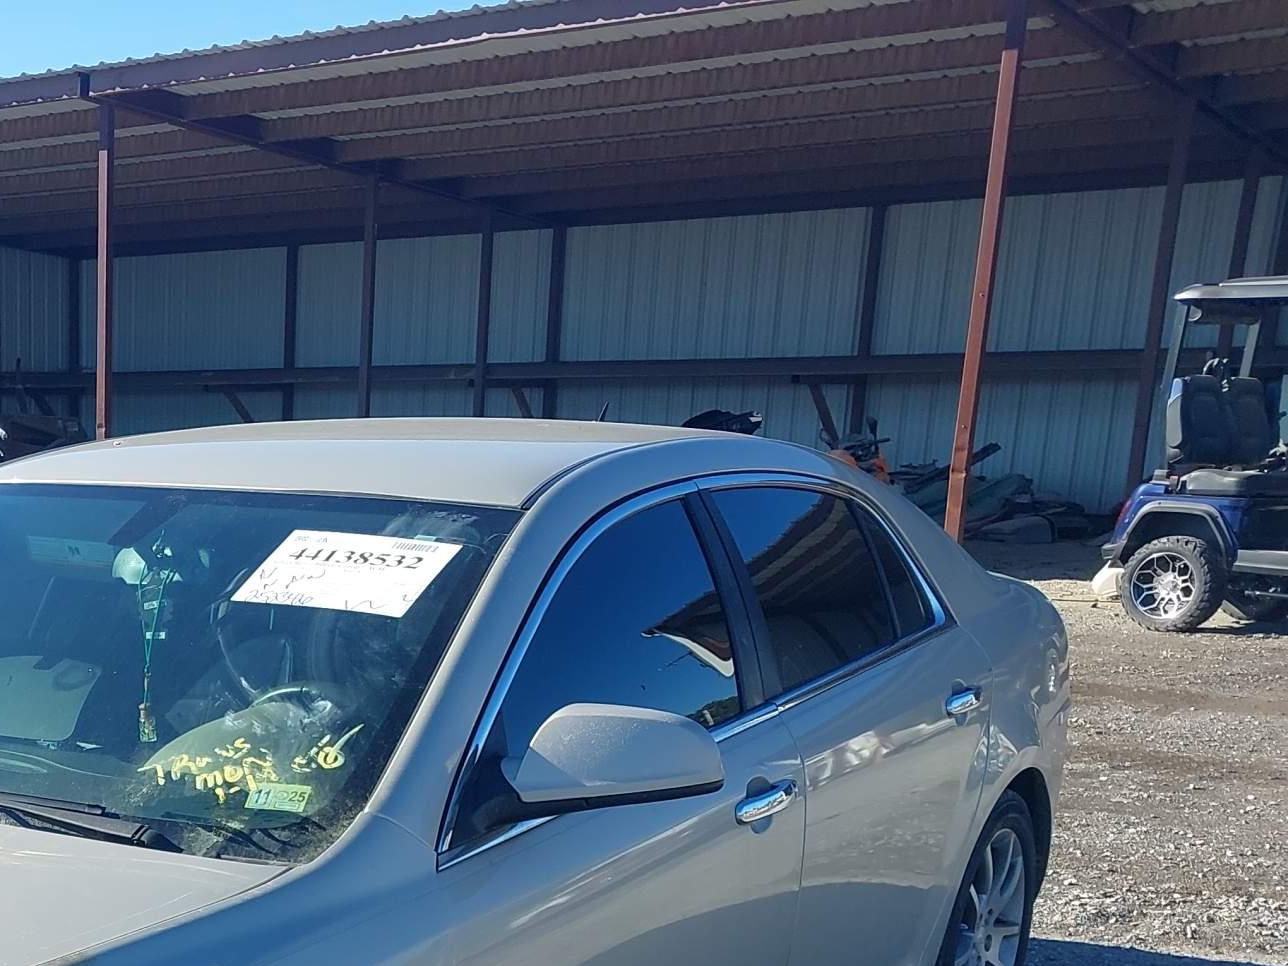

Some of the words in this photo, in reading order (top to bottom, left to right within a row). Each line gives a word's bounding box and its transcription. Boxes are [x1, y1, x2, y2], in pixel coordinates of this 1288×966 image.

[288, 547, 424, 570] 44138532
[255, 788, 272, 805] 11
[288, 791, 307, 803] 25
